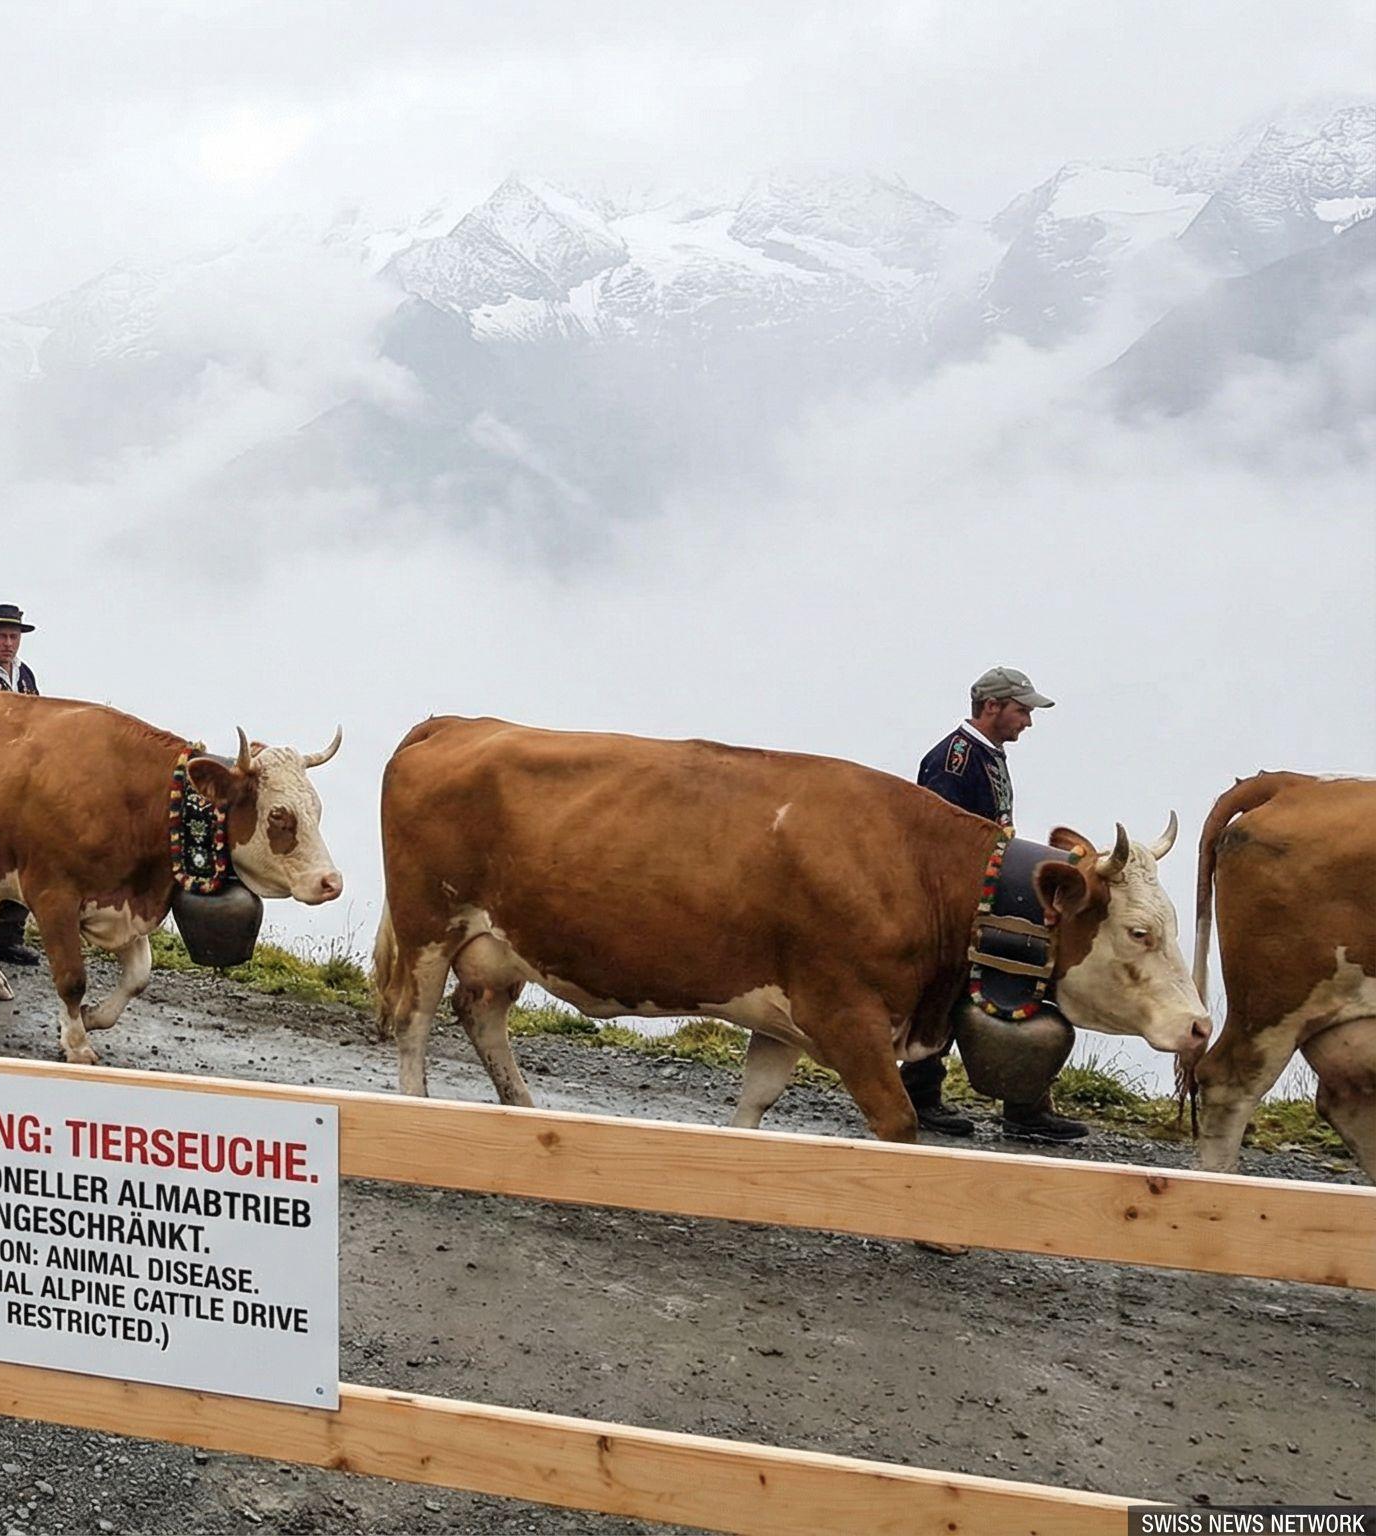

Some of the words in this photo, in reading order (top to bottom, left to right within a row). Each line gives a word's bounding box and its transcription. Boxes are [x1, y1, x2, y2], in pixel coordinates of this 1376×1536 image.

[66, 1121, 317, 1183] TIERSEUCHE.
[118, 1180, 311, 1227] ALMABTRIEB
[46, 1246, 139, 1278] ANIMAL
[149, 1258, 258, 1294] DISEASE.
[8, 1301, 168, 1350] RESTRICTED.)
[41, 1276, 125, 1308] ALPINE
[134, 1288, 224, 1321] CATTLE
[234, 1301, 308, 1333] DRIVE
